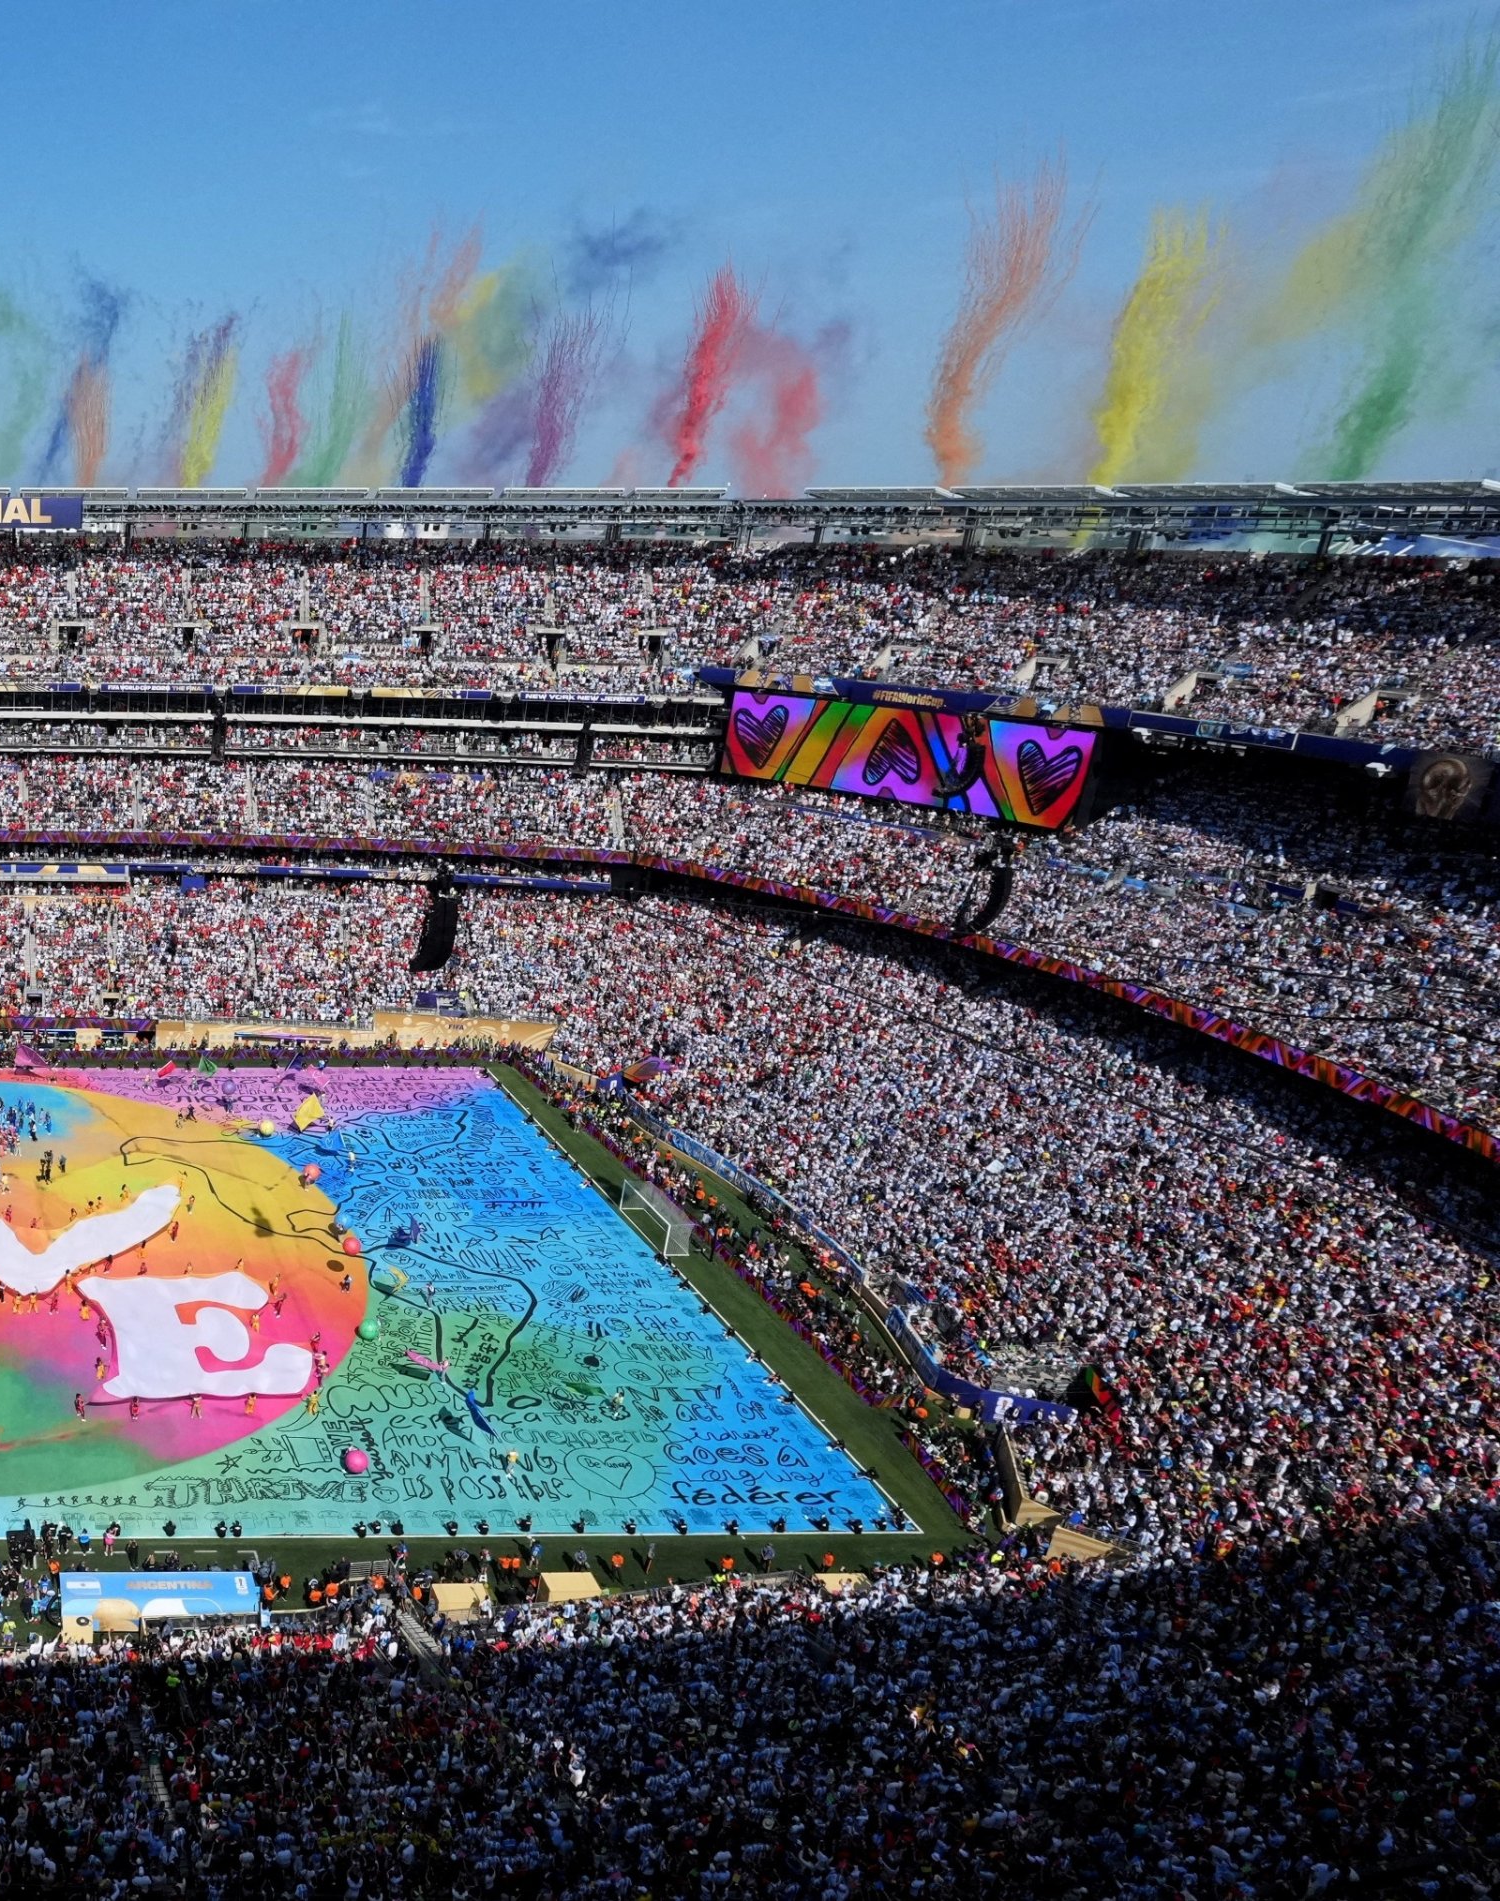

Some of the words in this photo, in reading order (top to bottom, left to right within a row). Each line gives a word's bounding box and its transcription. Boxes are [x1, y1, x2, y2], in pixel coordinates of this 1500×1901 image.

[576, 694, 599, 702] NEW
[600, 695, 639, 703] JERSEY
[872, 690, 944, 709] #FIFAWorldCup
[633, 1315, 685, 1330] take
[639, 1330, 702, 1341] action
[376, 1426, 455, 1449] Amor
[143, 1474, 374, 1508] THRIVE
[661, 1480, 849, 1505] fédérer
[127, 1579, 213, 1590] ARGENTINA
